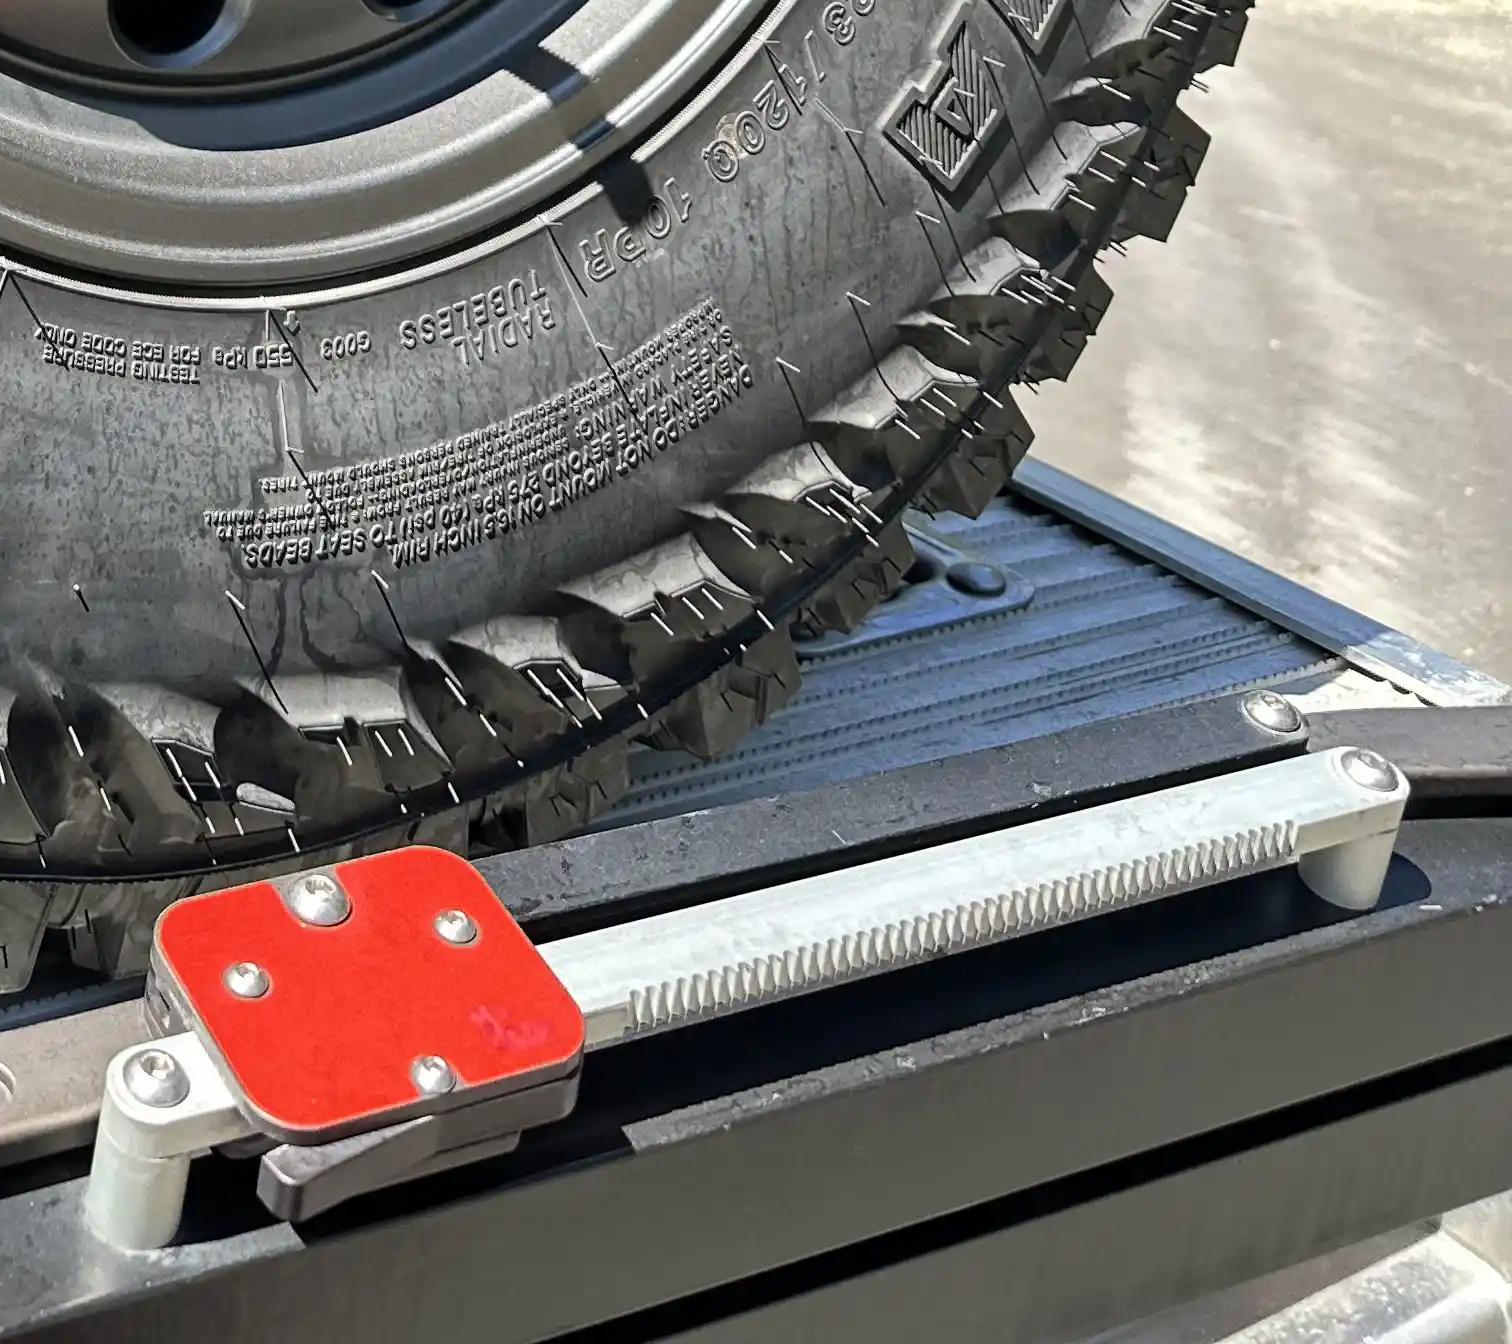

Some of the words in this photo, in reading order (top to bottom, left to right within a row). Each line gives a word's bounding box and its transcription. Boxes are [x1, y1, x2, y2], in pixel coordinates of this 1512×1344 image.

[579, 177, 692, 281] 10PR
[399, 267, 546, 350] TUBELESS
[33, 320, 77, 348] ONLY
[80, 331, 127, 357] CODE
[319, 330, 371, 360] G003
[455, 303, 555, 365] RADIAL
[42, 342, 126, 377] PRESSURE
[131, 340, 164, 363] ECE
[168, 344, 201, 365] FOR
[211, 345, 247, 370] kPa
[252, 341, 294, 368] 550
[670, 325, 732, 386] SAFETY
[130, 359, 200, 384] TESTING
[687, 344, 745, 401] NEVER
[573, 374, 667, 444] WARNING:
[616, 385, 693, 449] INFLATE
[542, 432, 619, 487] BEYOND
[610, 435, 652, 476] NOT
[548, 458, 612, 512] MOUNT
[515, 493, 546, 524] ON
[314, 527, 366, 560] SEAT
[368, 520, 398, 548] TO
[433, 518, 481, 555] INCH
[241, 536, 312, 568] BEADS.
[387, 536, 430, 568] RIM.
